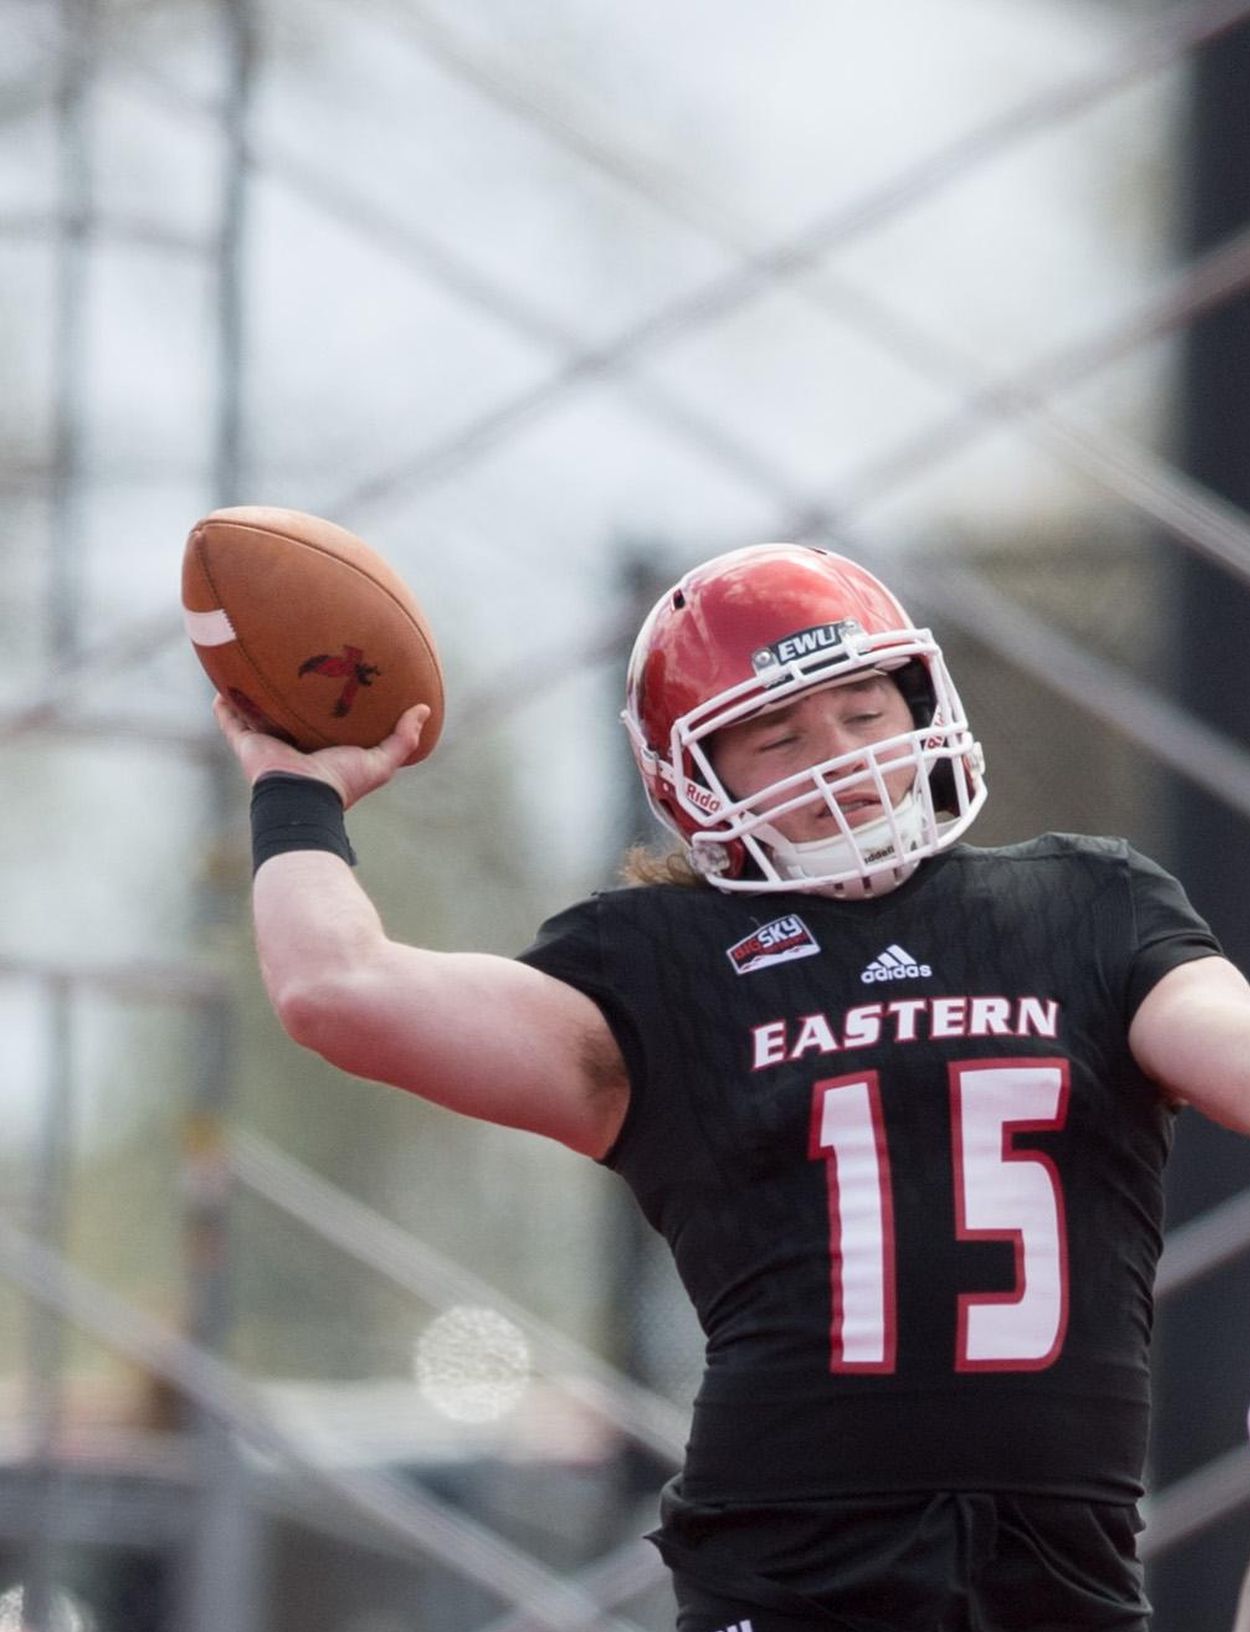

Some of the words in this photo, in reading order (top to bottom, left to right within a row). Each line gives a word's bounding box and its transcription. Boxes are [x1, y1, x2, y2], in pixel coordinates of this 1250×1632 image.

[778, 626, 836, 662] EWU
[686, 783, 721, 812] Ridd
[758, 917, 803, 949] SKY
[861, 964, 932, 984] adidas
[751, 996, 1060, 1071] EASTERN
[808, 1057, 1071, 1375] 15
